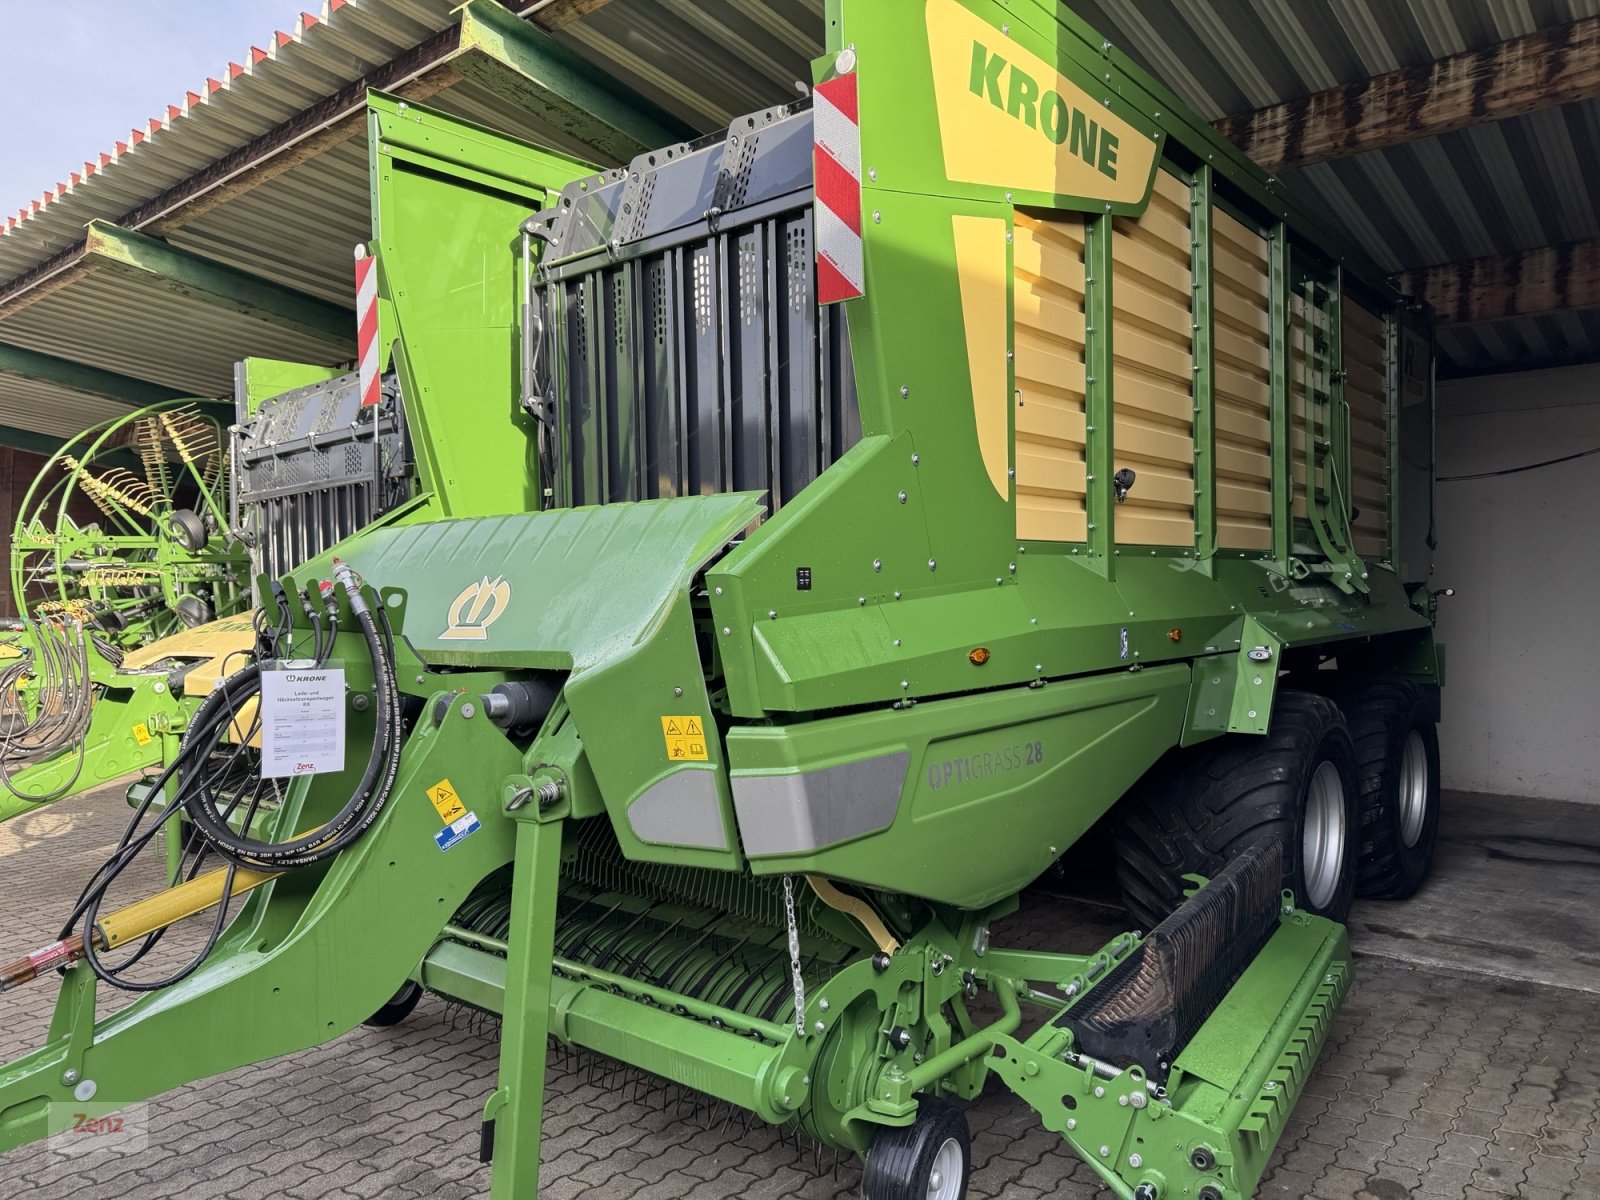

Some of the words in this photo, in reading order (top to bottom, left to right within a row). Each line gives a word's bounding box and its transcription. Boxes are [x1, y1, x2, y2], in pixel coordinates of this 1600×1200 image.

[968, 38, 1121, 182] KRONE
[928, 745, 1022, 790] OPTIGRASS
[1024, 740, 1044, 766] 28
[308, 839, 322, 848] BAR
